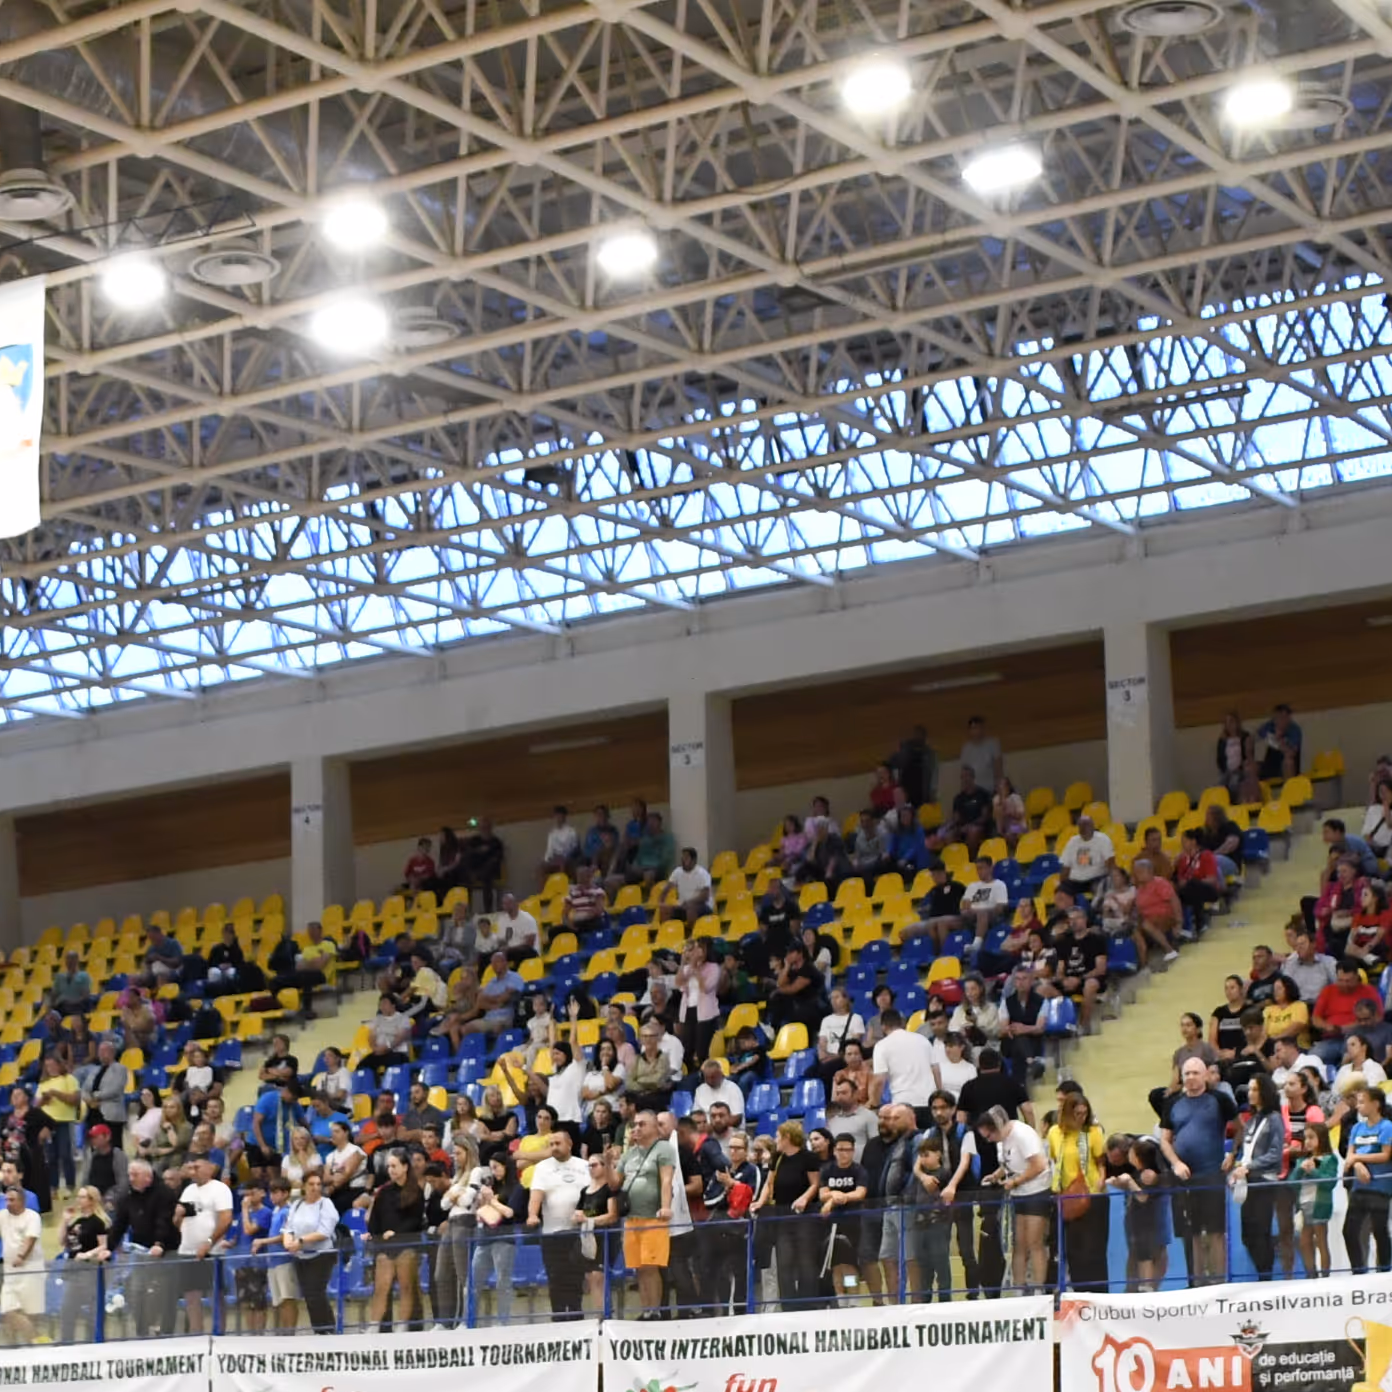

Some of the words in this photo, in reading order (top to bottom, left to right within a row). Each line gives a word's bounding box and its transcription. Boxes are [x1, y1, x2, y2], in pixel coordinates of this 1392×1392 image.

[1107, 677, 1146, 690] SECTOR
[1123, 691, 1131, 702] 3
[828, 1177, 854, 1188] BOSS
[1078, 1304, 1136, 1323] Clubul
[1143, 1302, 1208, 1322] Sportiv
[1216, 1295, 1343, 1317] Transilvania
[609, 1338, 666, 1361] YOUTH
[670, 1332, 810, 1360] INTERNATIONAL
[815, 1326, 911, 1354] HANDBALL
[915, 1317, 1048, 1348] TOURNAMENT
[32, 1359, 103, 1384] HANDBALL
[107, 1352, 206, 1380] TOURNAMENT
[217, 1353, 267, 1375] YOUTH
[271, 1350, 389, 1374] INTERNATIONAL
[394, 1346, 475, 1370] HANDBALL
[480, 1338, 594, 1367] TOURNAMENT
[1258, 1354, 1276, 1366] de
[1166, 1356, 1243, 1390] ANI
